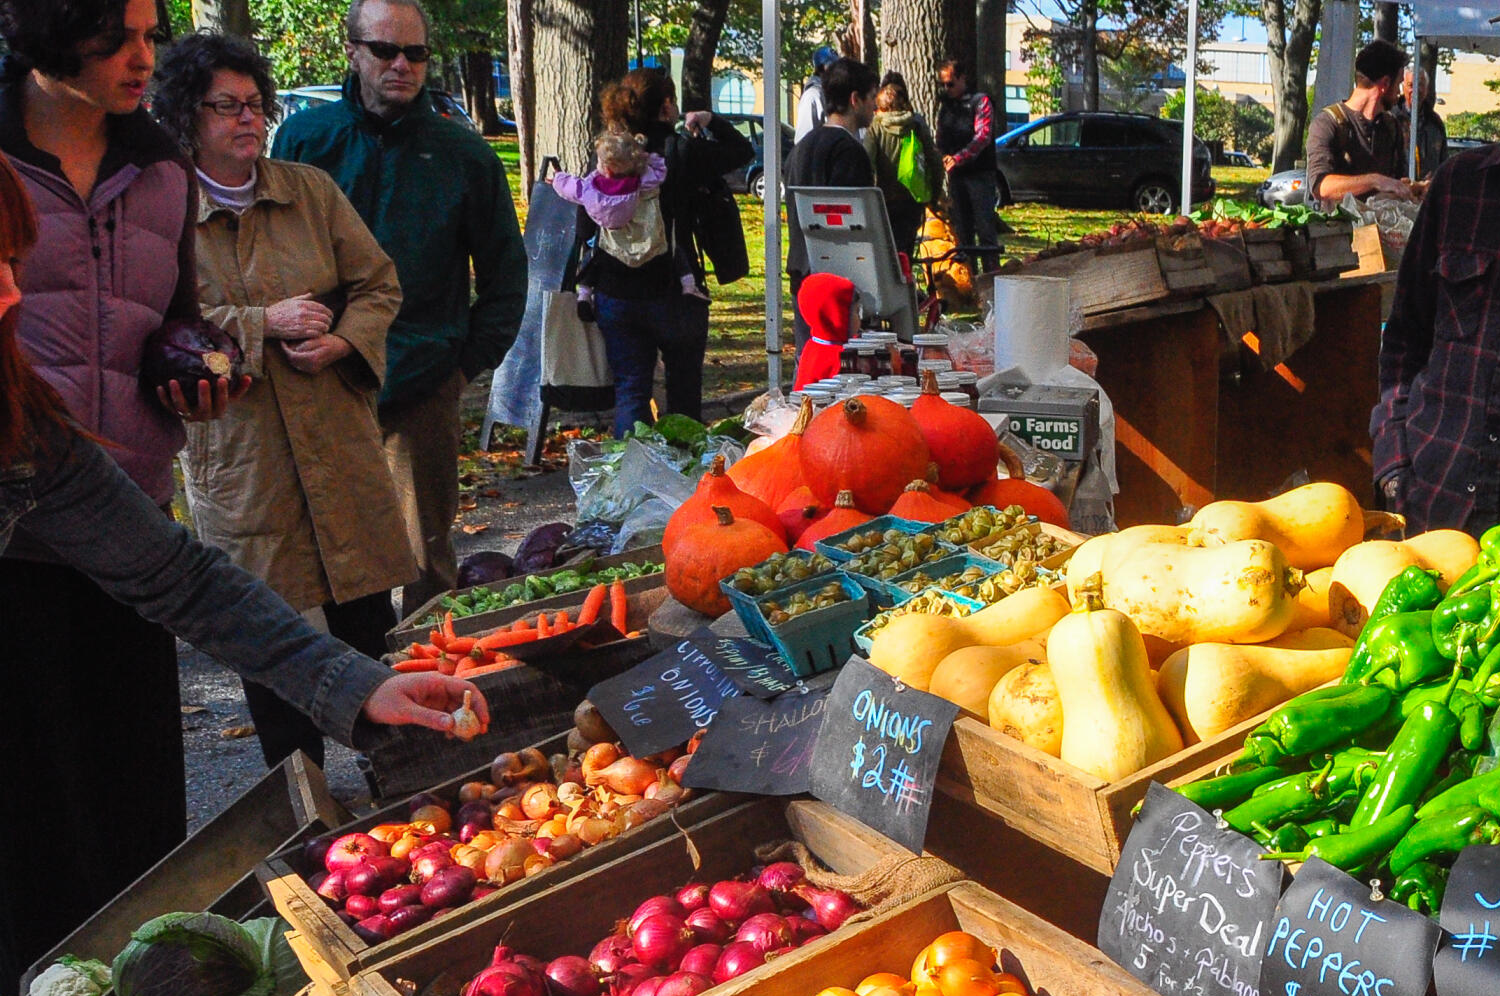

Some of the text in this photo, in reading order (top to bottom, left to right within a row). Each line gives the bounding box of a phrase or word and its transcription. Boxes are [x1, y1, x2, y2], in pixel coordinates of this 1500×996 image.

[1026, 418, 1079, 433] Farms
[1032, 435, 1073, 450] Food
[660, 667, 718, 727] ONIONS
[853, 690, 933, 754] ONIONS
[1158, 811, 1257, 899] Peppers
[1133, 847, 1263, 957] Super Deal
[1307, 888, 1388, 944] HOT
[1133, 944, 1155, 969] 5
